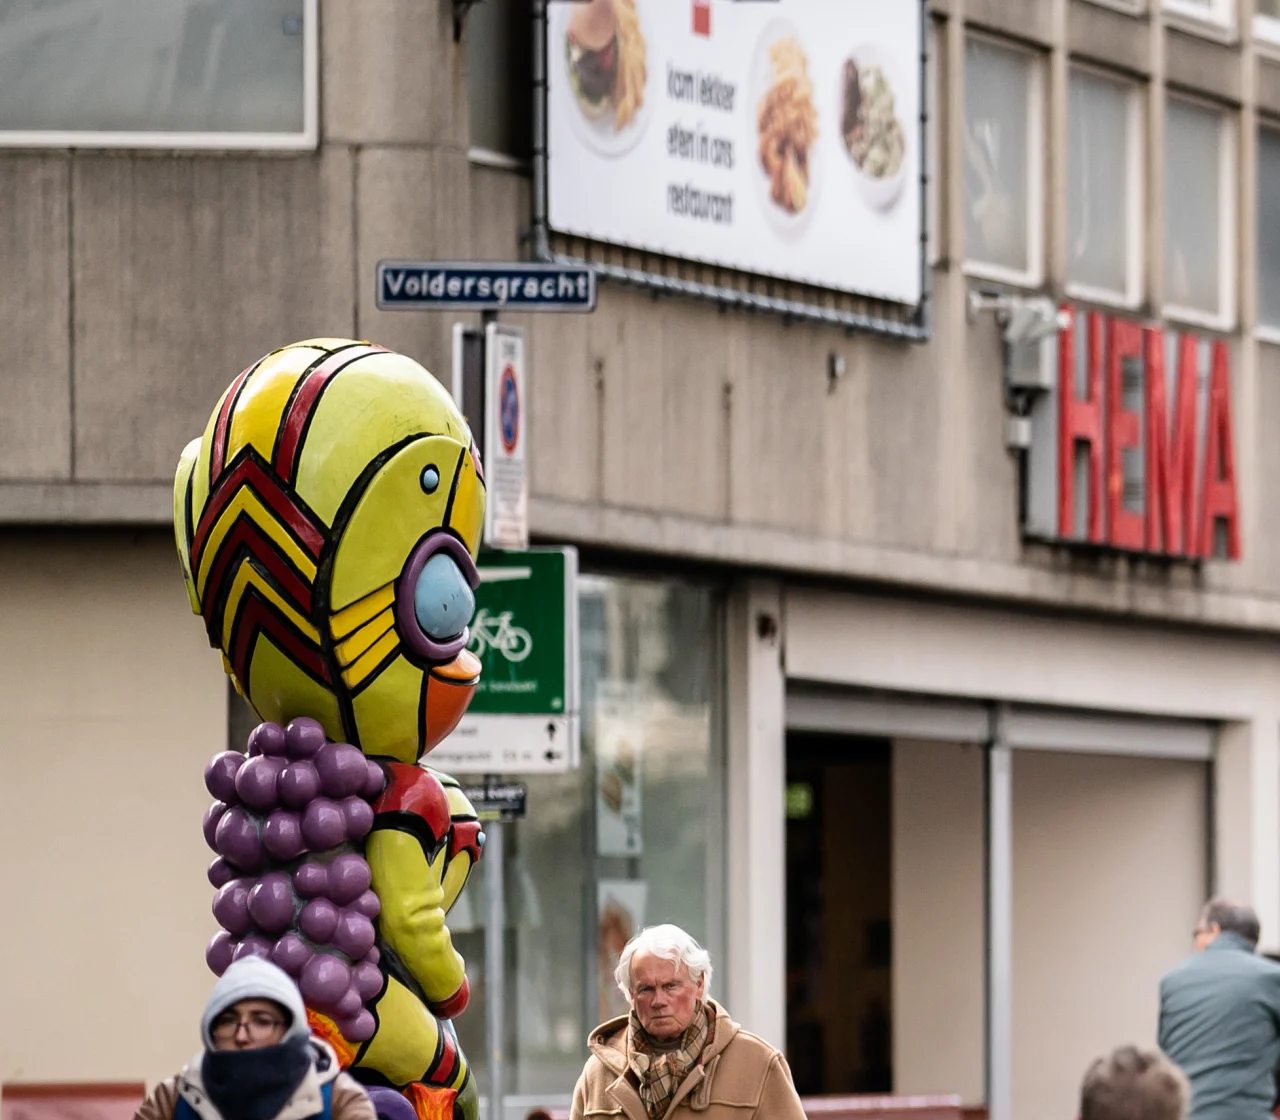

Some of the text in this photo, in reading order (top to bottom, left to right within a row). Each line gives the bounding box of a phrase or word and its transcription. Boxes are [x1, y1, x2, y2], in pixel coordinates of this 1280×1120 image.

[666, 178, 735, 224] restaurant
[387, 271, 588, 304] Voldersgracht
[1057, 303, 1242, 563] HEMA
